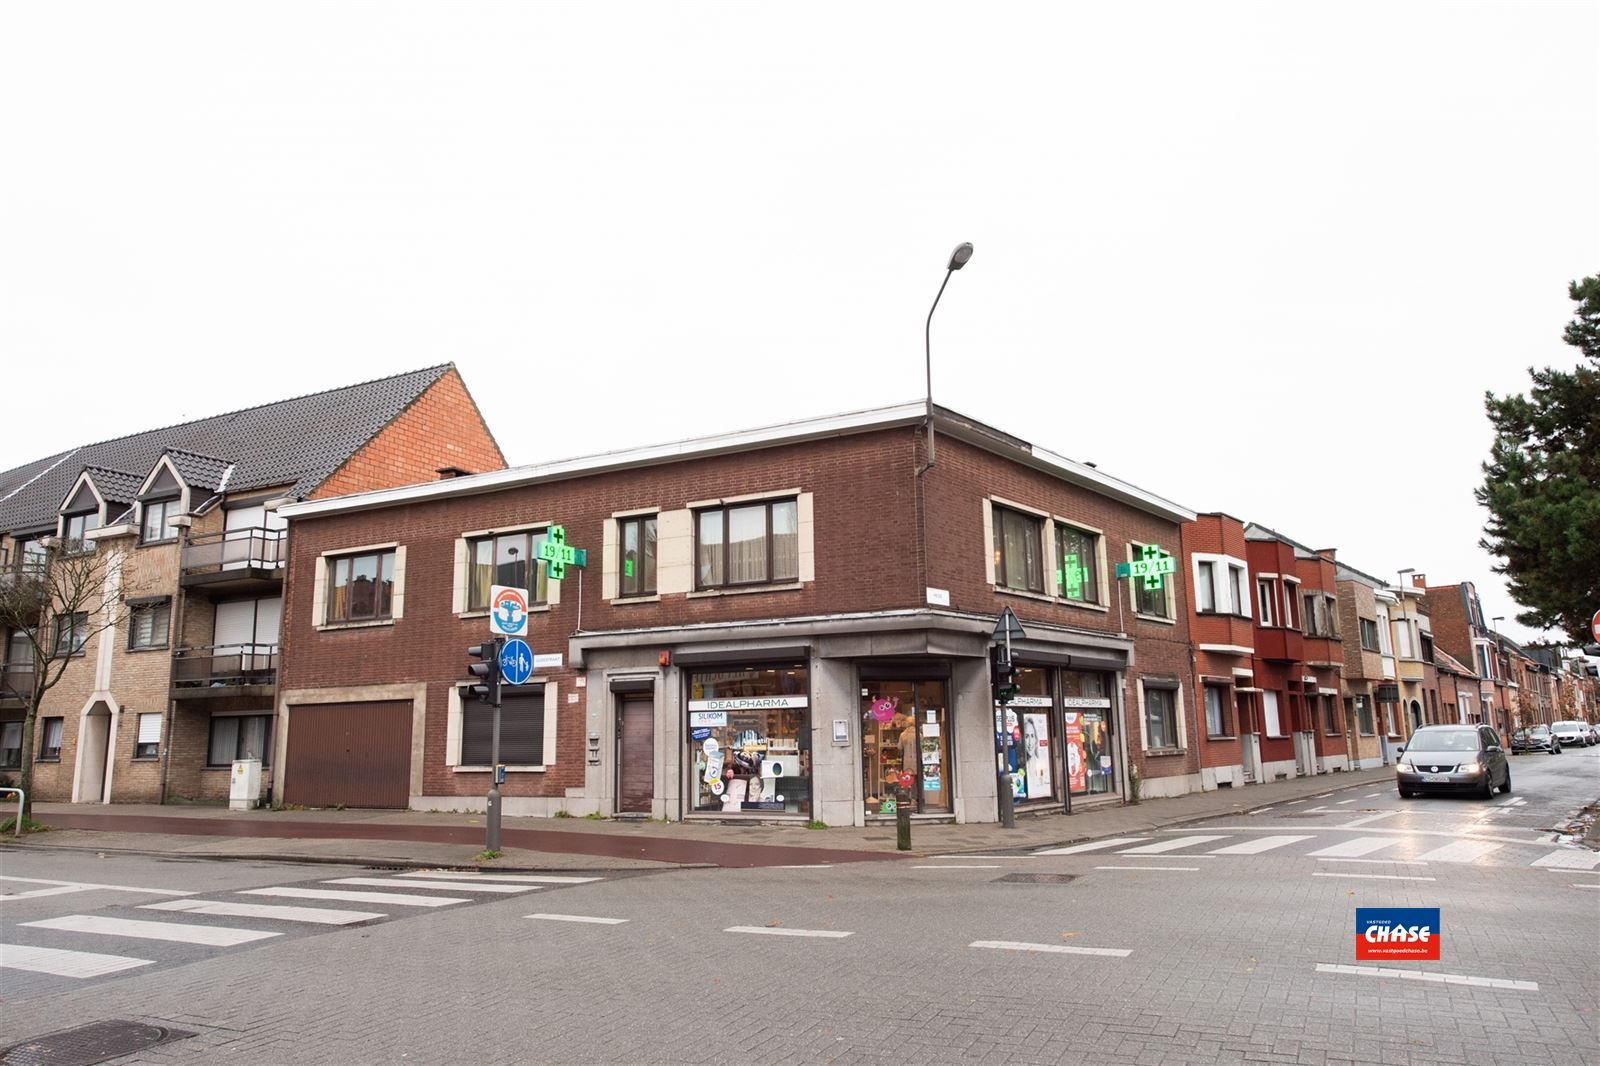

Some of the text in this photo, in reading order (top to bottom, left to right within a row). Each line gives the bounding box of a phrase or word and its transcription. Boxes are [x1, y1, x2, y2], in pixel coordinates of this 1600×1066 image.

[545, 545, 571, 561] 19/11
[1134, 560, 1169, 574] 19/11
[707, 699, 789, 709] IDEALPHARMA
